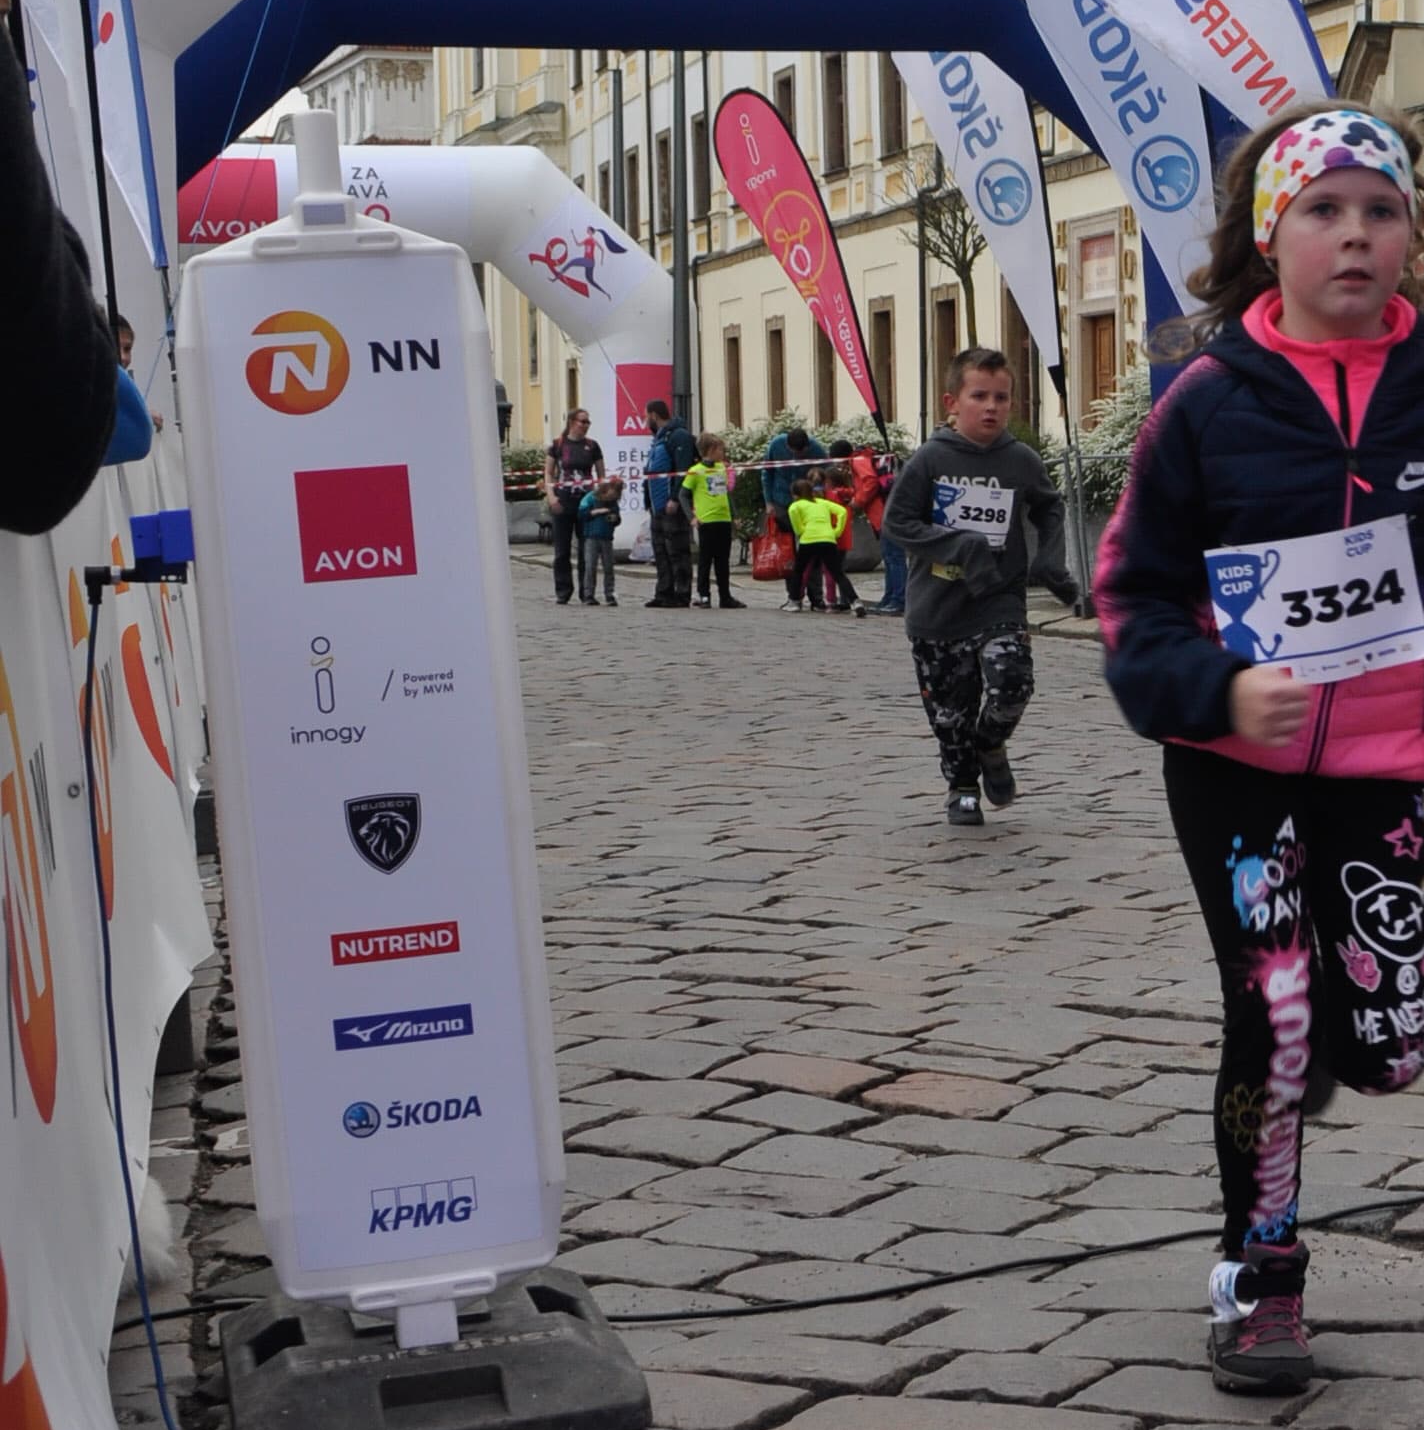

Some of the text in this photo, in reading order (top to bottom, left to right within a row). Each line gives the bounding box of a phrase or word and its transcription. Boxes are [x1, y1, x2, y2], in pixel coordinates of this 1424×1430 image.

[352, 167, 379, 180] ZA
[370, 338, 440, 373] NN
[959, 505, 1007, 524] 3298
[1344, 529, 1374, 546] KIDS
[314, 545, 404, 573] AVON
[1346, 542, 1372, 558] CUP
[1216, 564, 1254, 581] KIDS
[1220, 580, 1253, 596] CUP
[1281, 568, 1406, 628] 3324
[403, 669, 454, 684] Powered
[404, 683, 454, 699] by MVM
[290, 725, 367, 745] innogy
[351, 800, 413, 813] PEUGEOT
[338, 928, 454, 959] NUTREND
[385, 1094, 483, 1130] ŠKODA
[368, 1195, 473, 1235] KPMG
